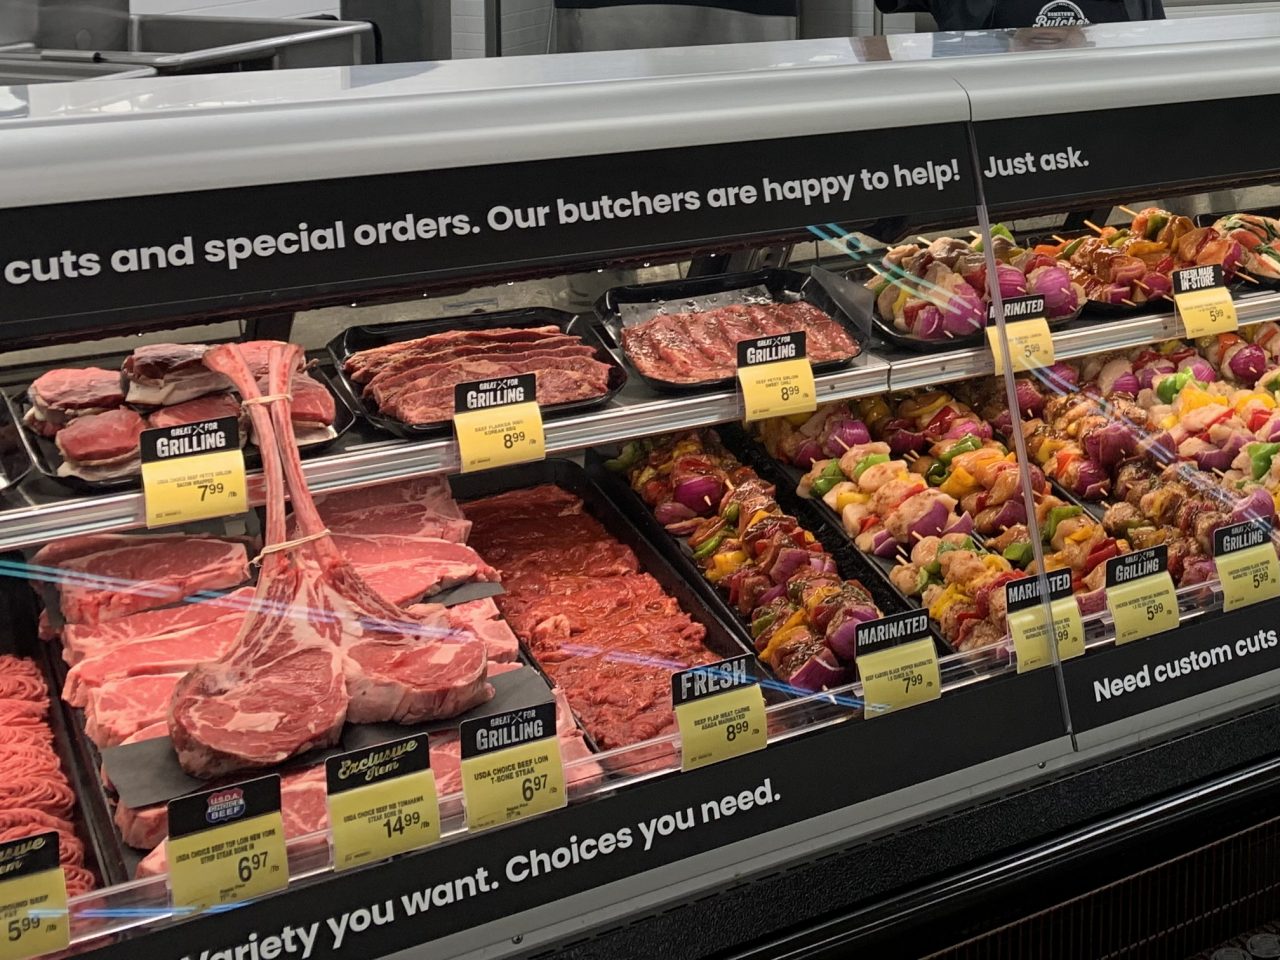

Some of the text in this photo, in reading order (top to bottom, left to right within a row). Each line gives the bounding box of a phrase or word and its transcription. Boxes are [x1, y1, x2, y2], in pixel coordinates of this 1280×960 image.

[984, 146, 1090, 180] Just ask.
[4, 159, 960, 285] cuts and special orders. Our butchers are happy to help!
[1181, 276, 1215, 291] IN-STORE
[746, 344, 796, 364] GRILLING
[479, 378, 519, 391] GREAT FOR
[466, 387, 525, 409] GRILLING
[171, 422, 218, 437] GREAT FOR
[156, 432, 226, 458] GRILLING
[1223, 530, 1263, 552] GRILLING
[1116, 558, 1160, 583] GRILLING
[858, 616, 928, 647] MARINATED
[1094, 664, 1151, 702] Need
[1154, 645, 1233, 683] custom
[1235, 629, 1278, 657] cuts
[681, 659, 747, 700] FRESH
[490, 710, 536, 727] GREAT FOR
[476, 720, 543, 751] GRILLING
[338, 740, 418, 780] Exclusive
[365, 760, 399, 781] Item
[474, 755, 549, 781] USDA CHOICE BEEF LOIN
[491, 767, 535, 784] T-BONE STEAK
[211, 806, 241, 820] BEEF
[180, 778, 781, 960] ariety you want. Choices you need.
